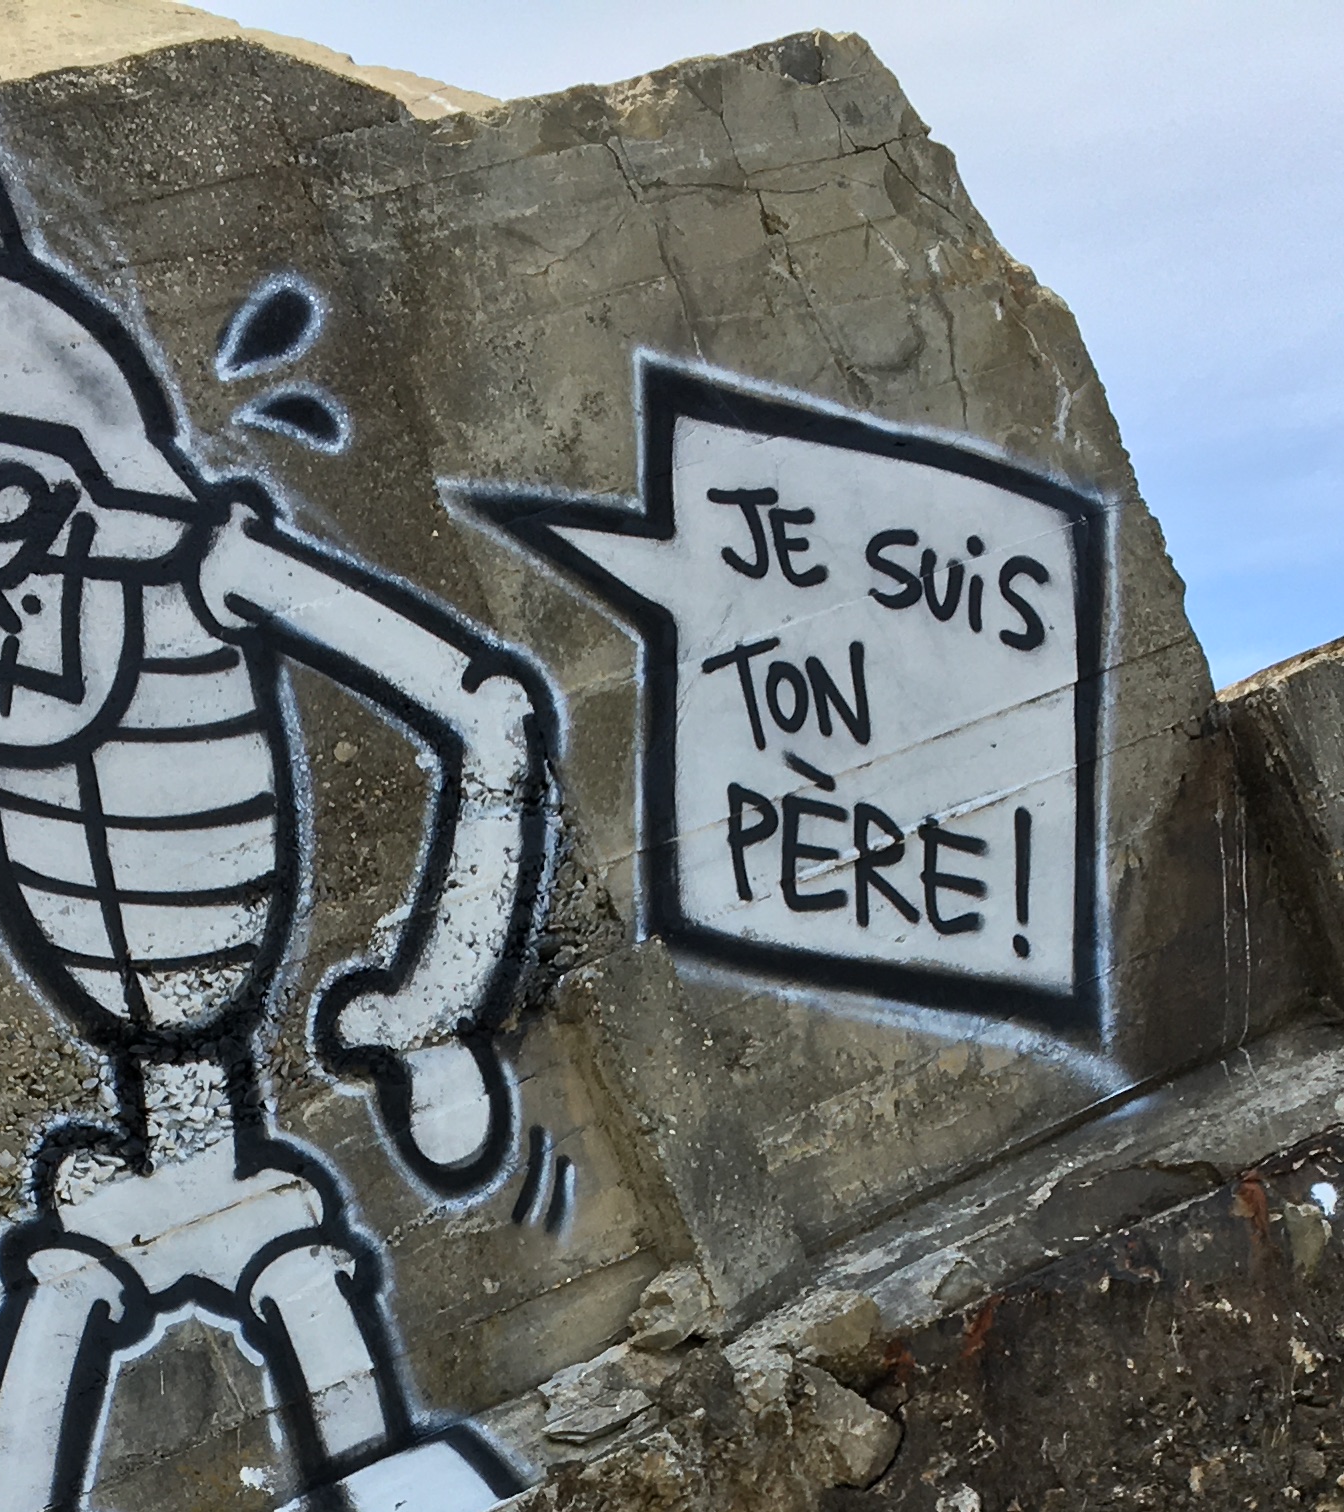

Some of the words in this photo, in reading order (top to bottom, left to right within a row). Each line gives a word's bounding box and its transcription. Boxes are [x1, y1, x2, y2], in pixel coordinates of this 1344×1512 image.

[707, 487, 828, 588] JE
[701, 636, 871, 751] TON
[726, 751, 1032, 959] PÈRE!
